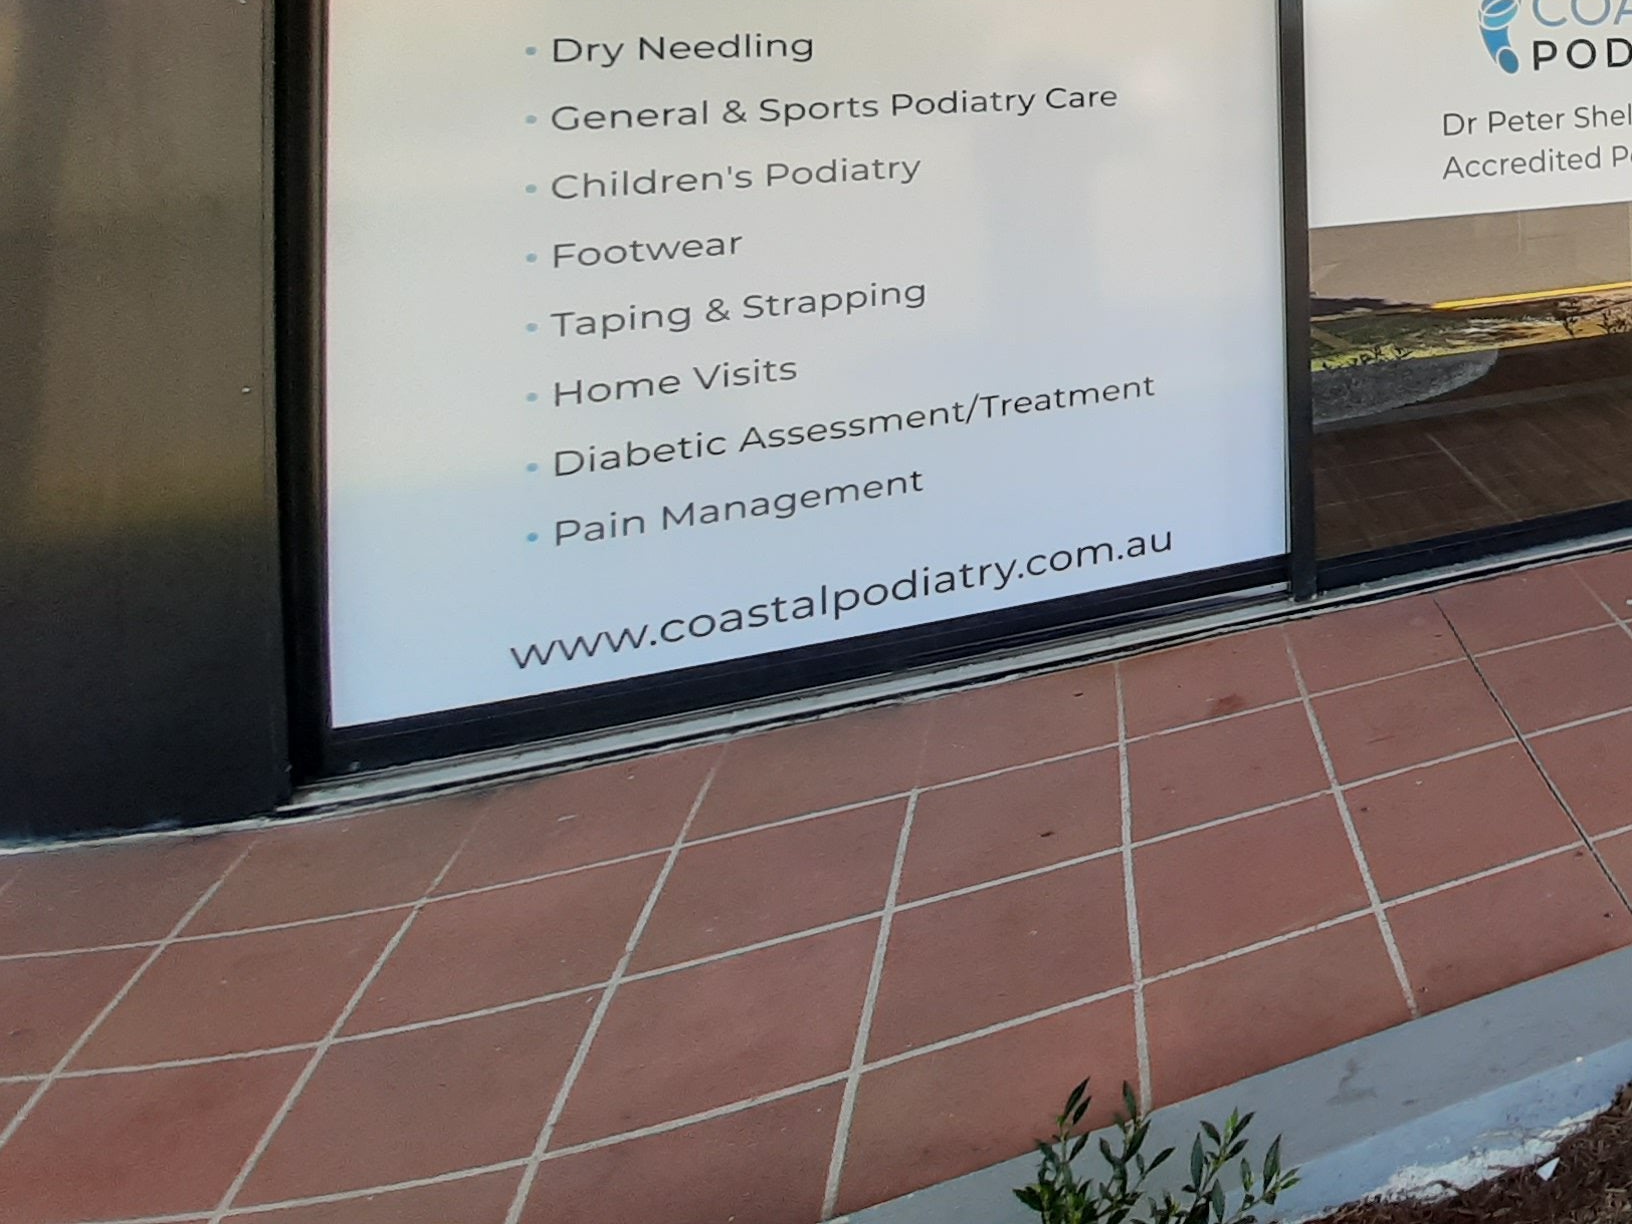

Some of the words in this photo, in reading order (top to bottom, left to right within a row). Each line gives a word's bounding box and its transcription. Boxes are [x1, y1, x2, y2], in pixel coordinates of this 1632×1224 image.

[554, 39, 624, 67] Dry
[640, 34, 812, 62] Needling
[552, 100, 707, 130] General
[723, 100, 746, 123] &
[760, 98, 878, 126] Sports
[892, 90, 1035, 116] Podiatry
[1046, 88, 1117, 109] Care
[1444, 113, 1477, 136] Dr
[1489, 111, 1564, 133] Peter
[552, 166, 752, 199] Children's
[767, 158, 920, 186] Podiatry
[1443, 146, 1600, 179] Accredited
[554, 236, 742, 268] Footwear
[551, 305, 691, 339] Taping
[706, 299, 730, 322] &
[744, 283, 924, 318] Strapping
[555, 376, 680, 406] Home
[693, 359, 796, 389] Visits
[555, 432, 726, 476] Diabetic
[739, 376, 1155, 453] Assessment/Treatment
[556, 512, 644, 546] Pain
[663, 471, 923, 530] Management
[509, 529, 1173, 671] www.coastalpodiatry.com.au
